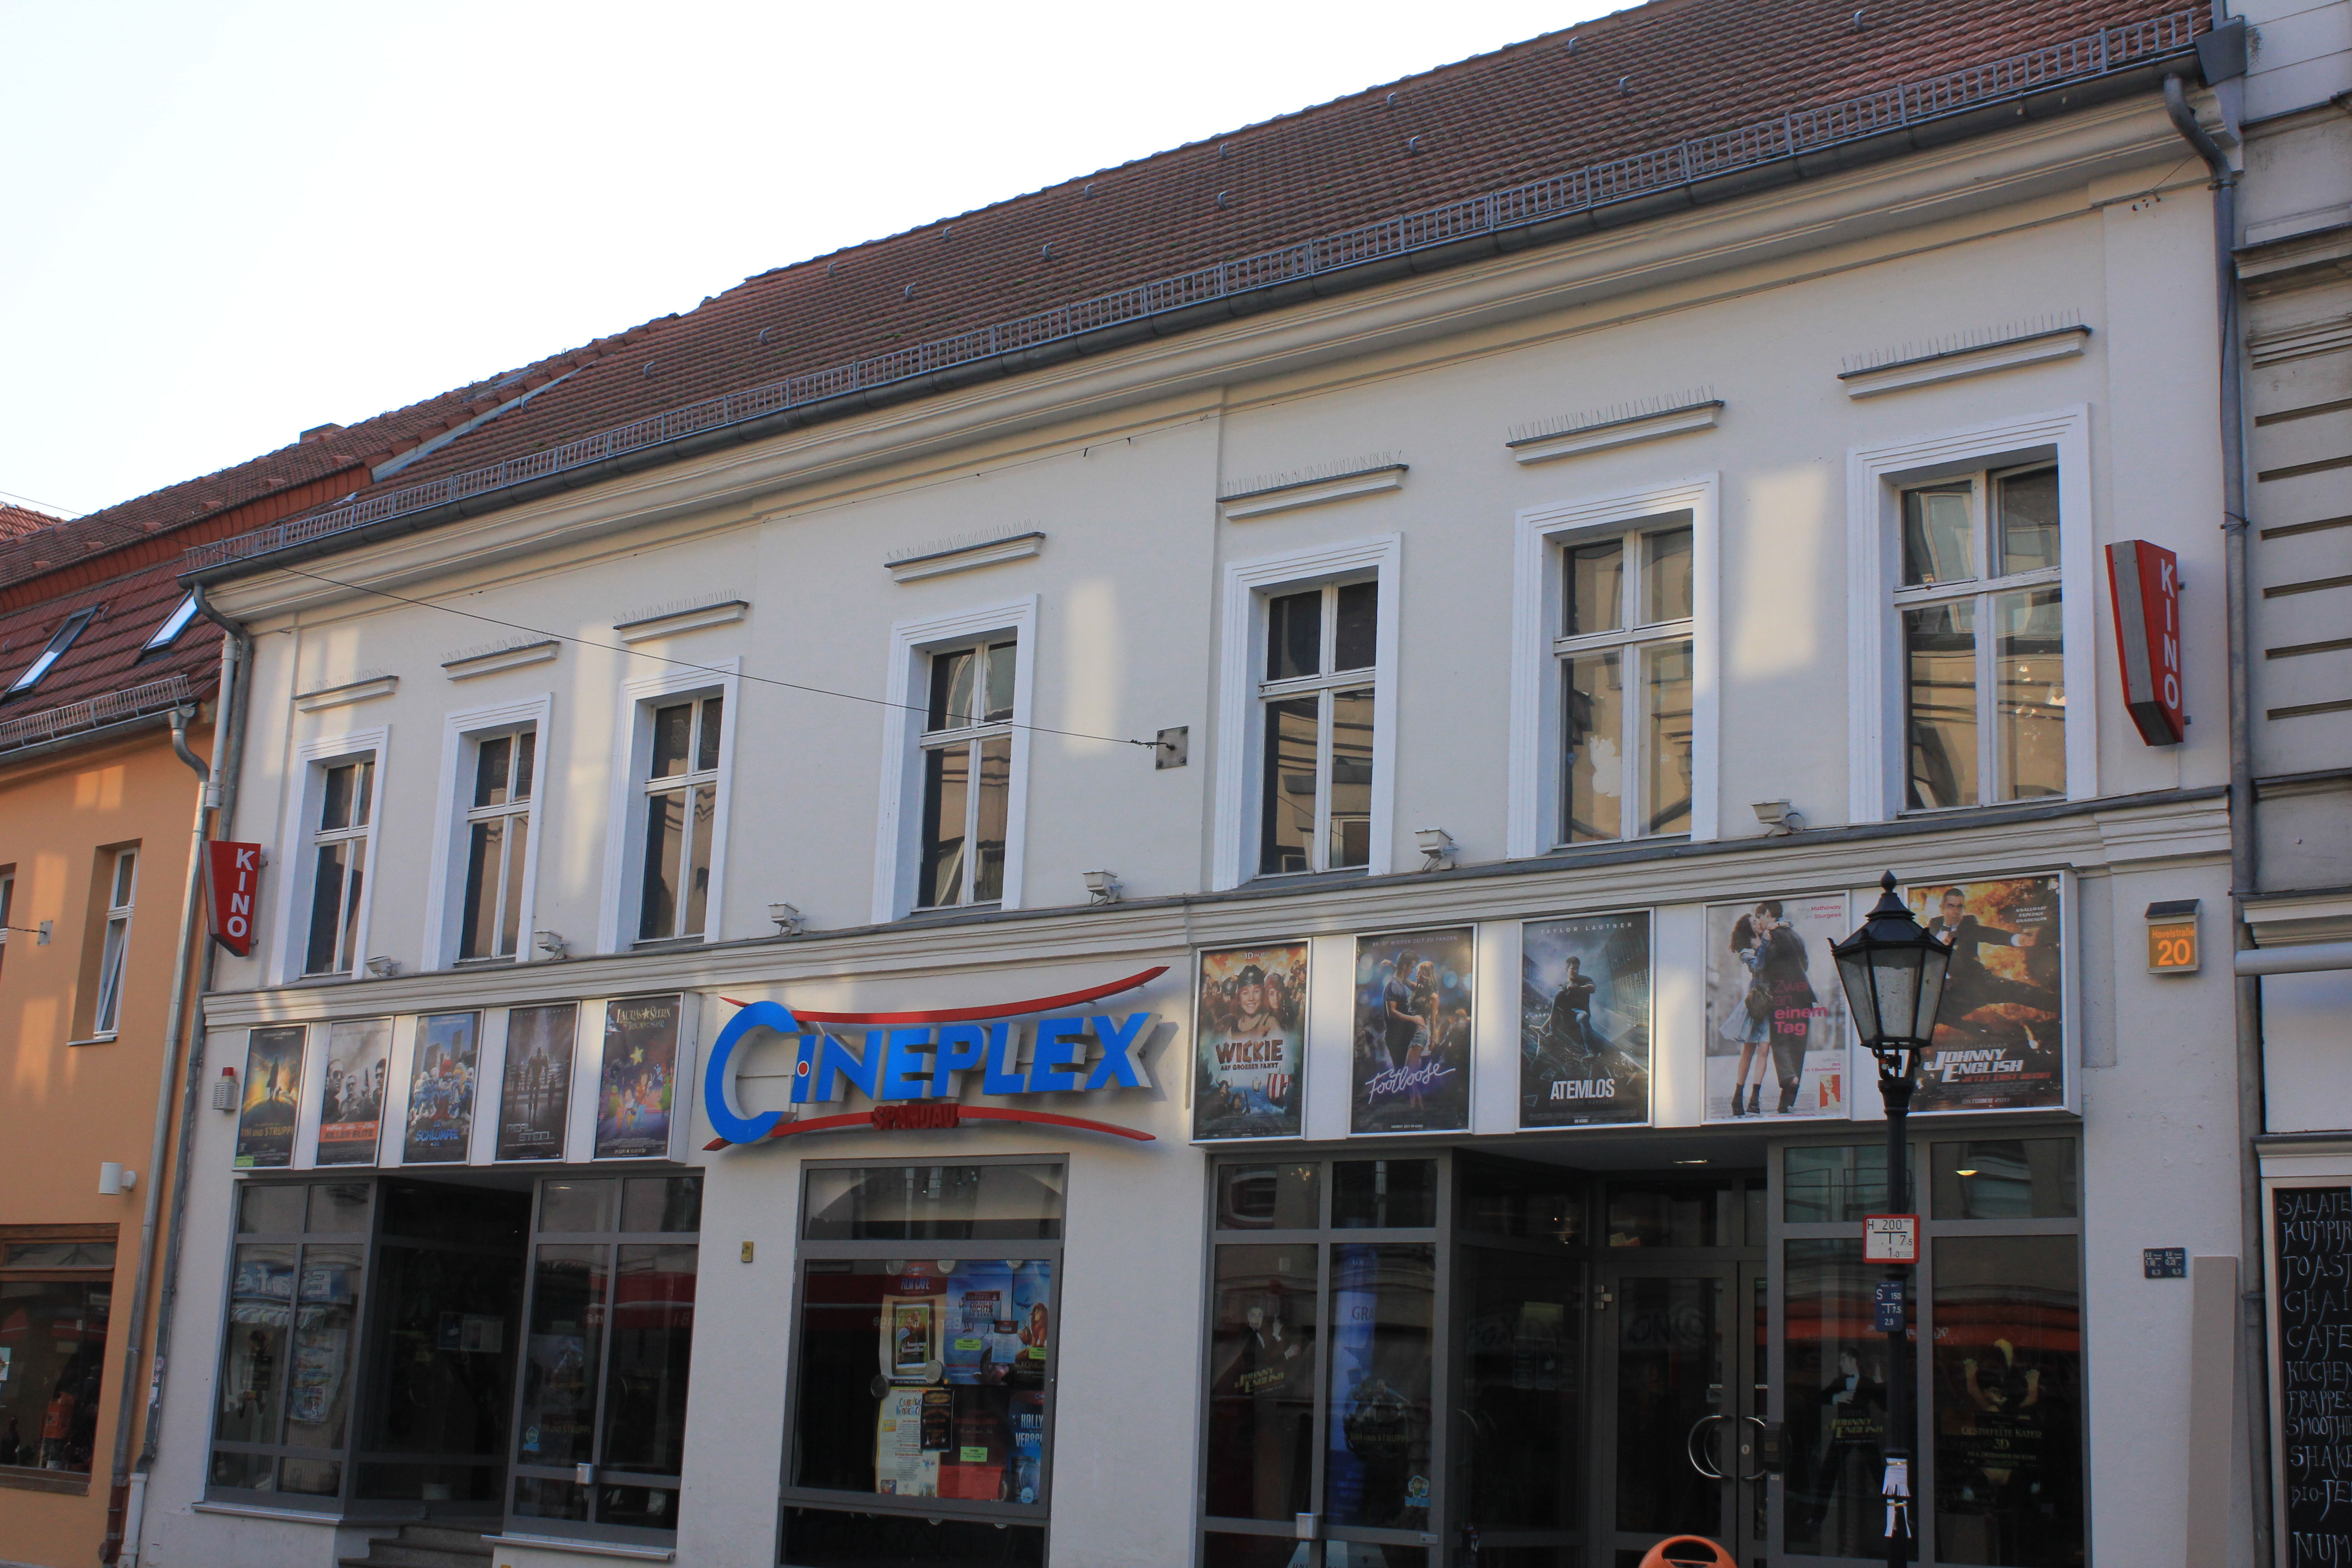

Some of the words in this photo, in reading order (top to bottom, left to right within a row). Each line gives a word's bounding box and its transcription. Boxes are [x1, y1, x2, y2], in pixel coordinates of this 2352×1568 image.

[2161, 559, 2178, 710] KINO
[227, 848, 255, 937] KINO
[1586, 922, 1632, 931] LAUTNER
[2152, 927, 2195, 938] Havelstraße
[2158, 939, 2190, 965] 20
[1774, 1006, 1828, 1019] einem
[1774, 1021, 1807, 1036] Tag
[1215, 1039, 1283, 1064] WICKIE
[1923, 1048, 2007, 1071] JOHNNY
[705, 1000, 1162, 1145] CINEPLEX
[1941, 1059, 2025, 1083] ENGLISH
[1365, 1062, 1456, 1104] Footloose
[1550, 1078, 1615, 1100] ATEMLOS
[506, 1123, 534, 1132] REAL
[873, 1103, 960, 1130] SPANDAU
[1867, 1220, 1874, 1230] H
[1882, 1219, 1901, 1230] 200
[2281, 1220, 2352, 1254] KUMPIR
[2282, 1254, 2352, 1289] TOAST
[901, 1278, 913, 1290] FILM
[1876, 1289, 1882, 1300] S
[2284, 1289, 2349, 1325] CHAI
[1021, 1413, 1044, 1429] HOLLY
[1994, 1439, 2011, 1449] 3D
[2291, 1480, 2352, 1521] BIO-TE
